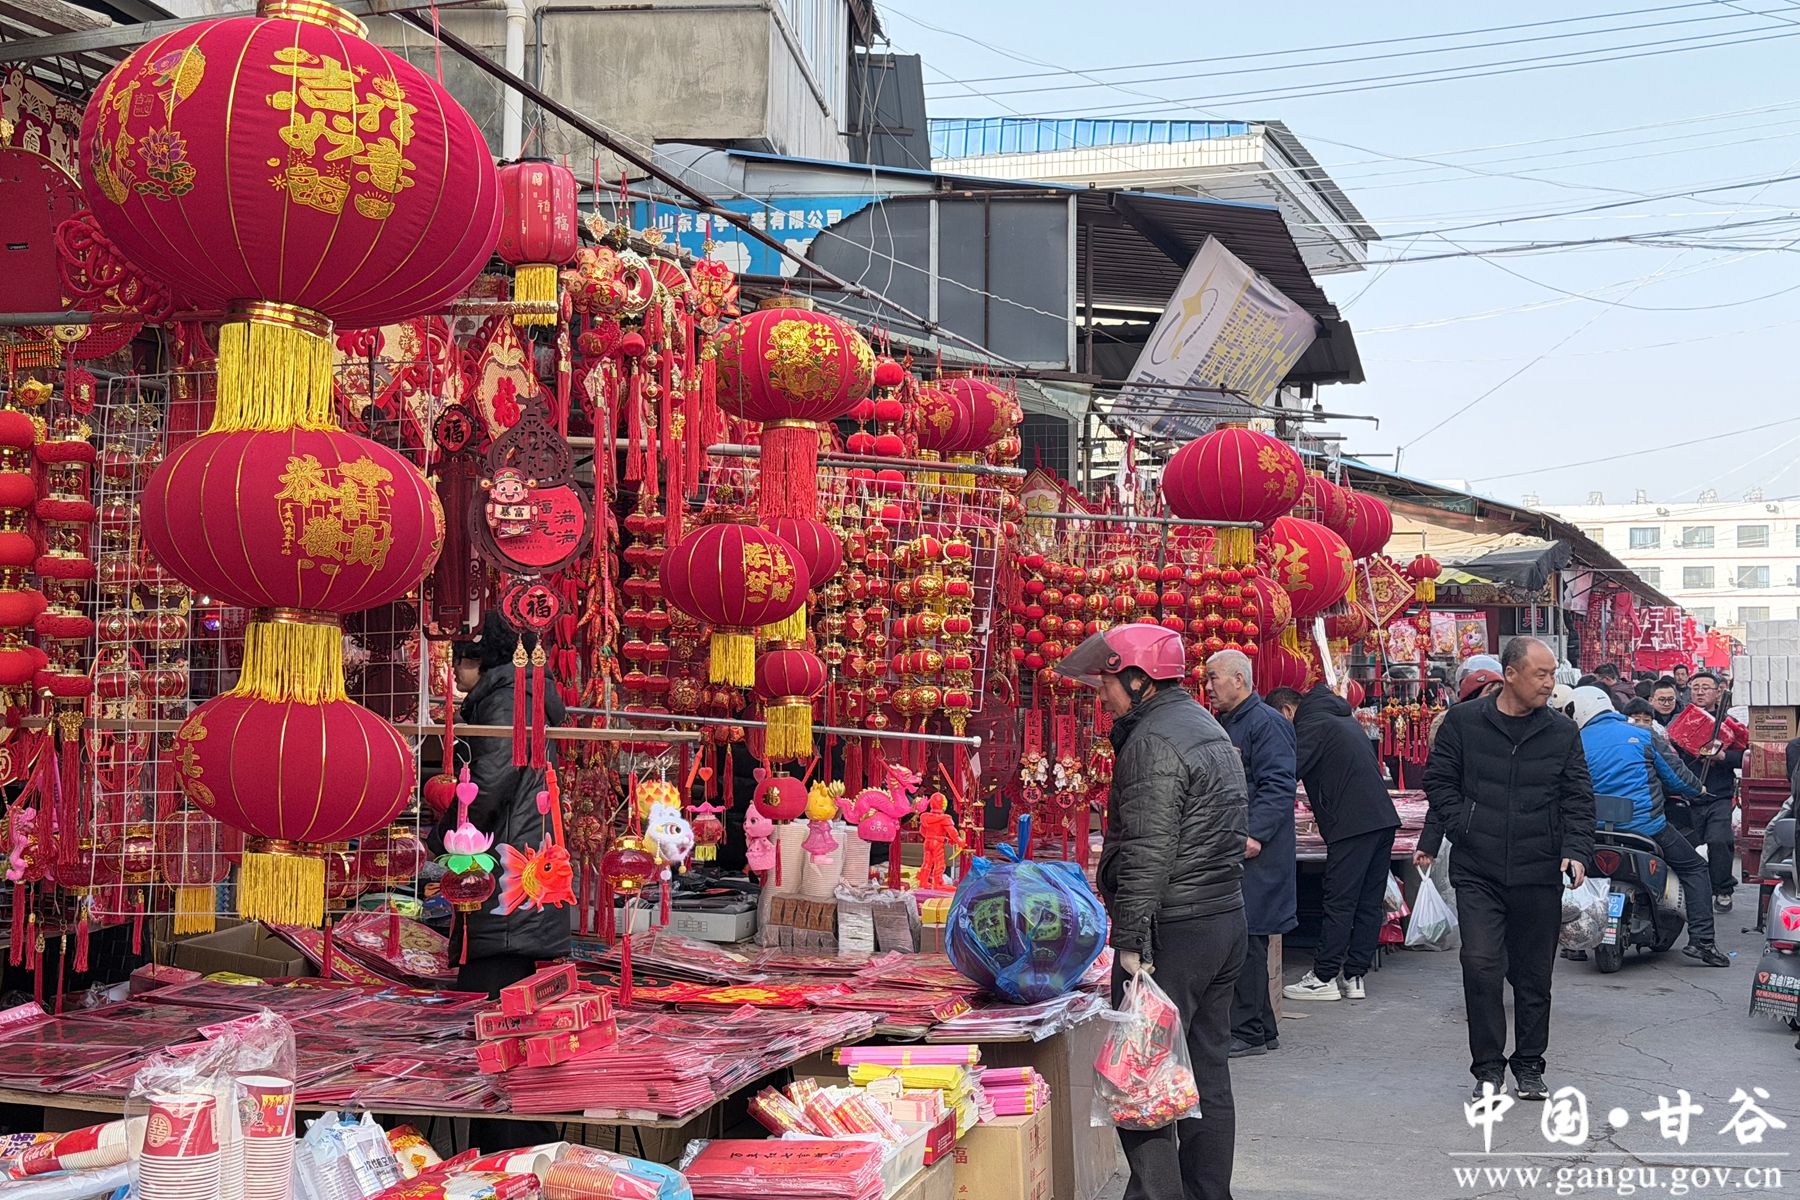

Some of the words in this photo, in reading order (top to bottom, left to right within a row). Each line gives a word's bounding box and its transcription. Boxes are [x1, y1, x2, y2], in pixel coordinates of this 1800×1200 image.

[658, 209, 842, 233] 山东星宇套有限公司
[811, 321, 841, 356] 牡丹
[445, 419, 464, 444] 福
[501, 506, 525, 518] 暴富
[554, 510, 578, 545] 满满
[527, 594, 549, 619] 福
